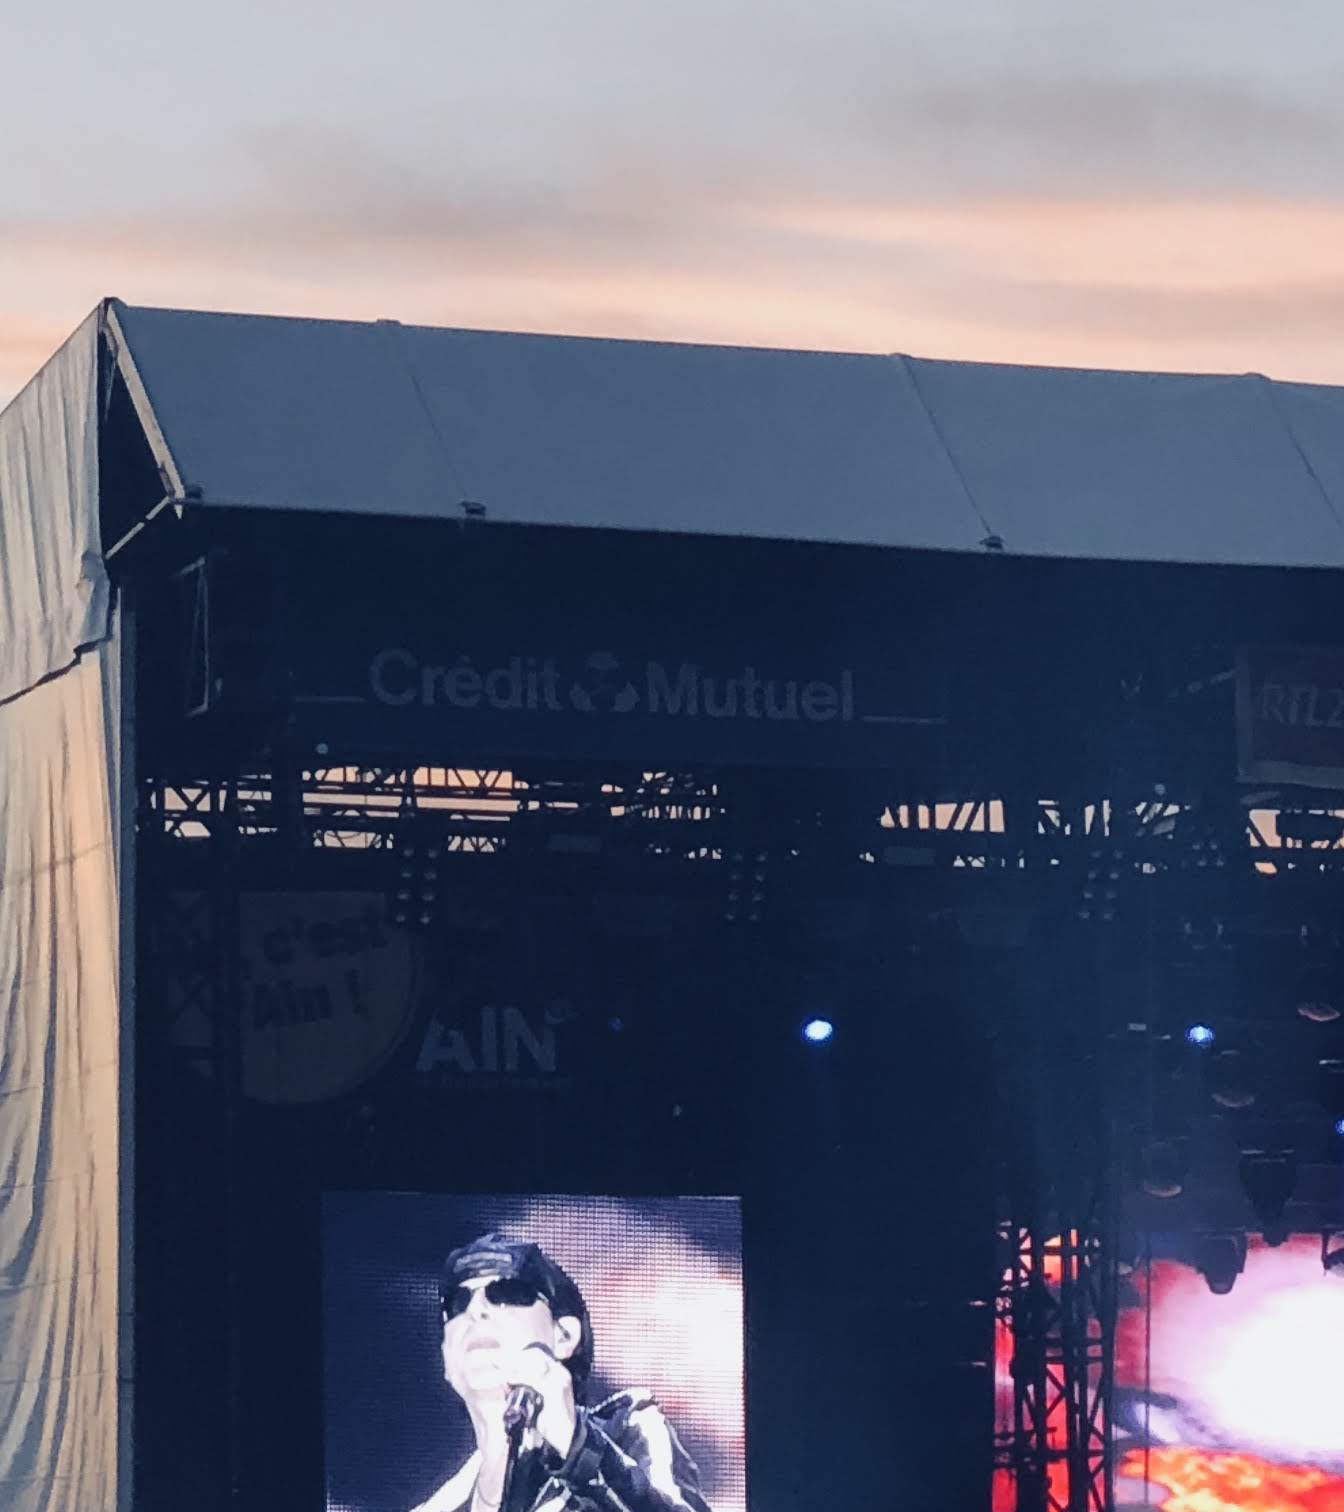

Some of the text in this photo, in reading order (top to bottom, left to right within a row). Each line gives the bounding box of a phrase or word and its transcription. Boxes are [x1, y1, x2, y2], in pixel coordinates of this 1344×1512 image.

[369, 648, 855, 721] Crédit Mutuel
[1256, 684, 1344, 727] RTL2
[415, 1006, 557, 1072] AIN
